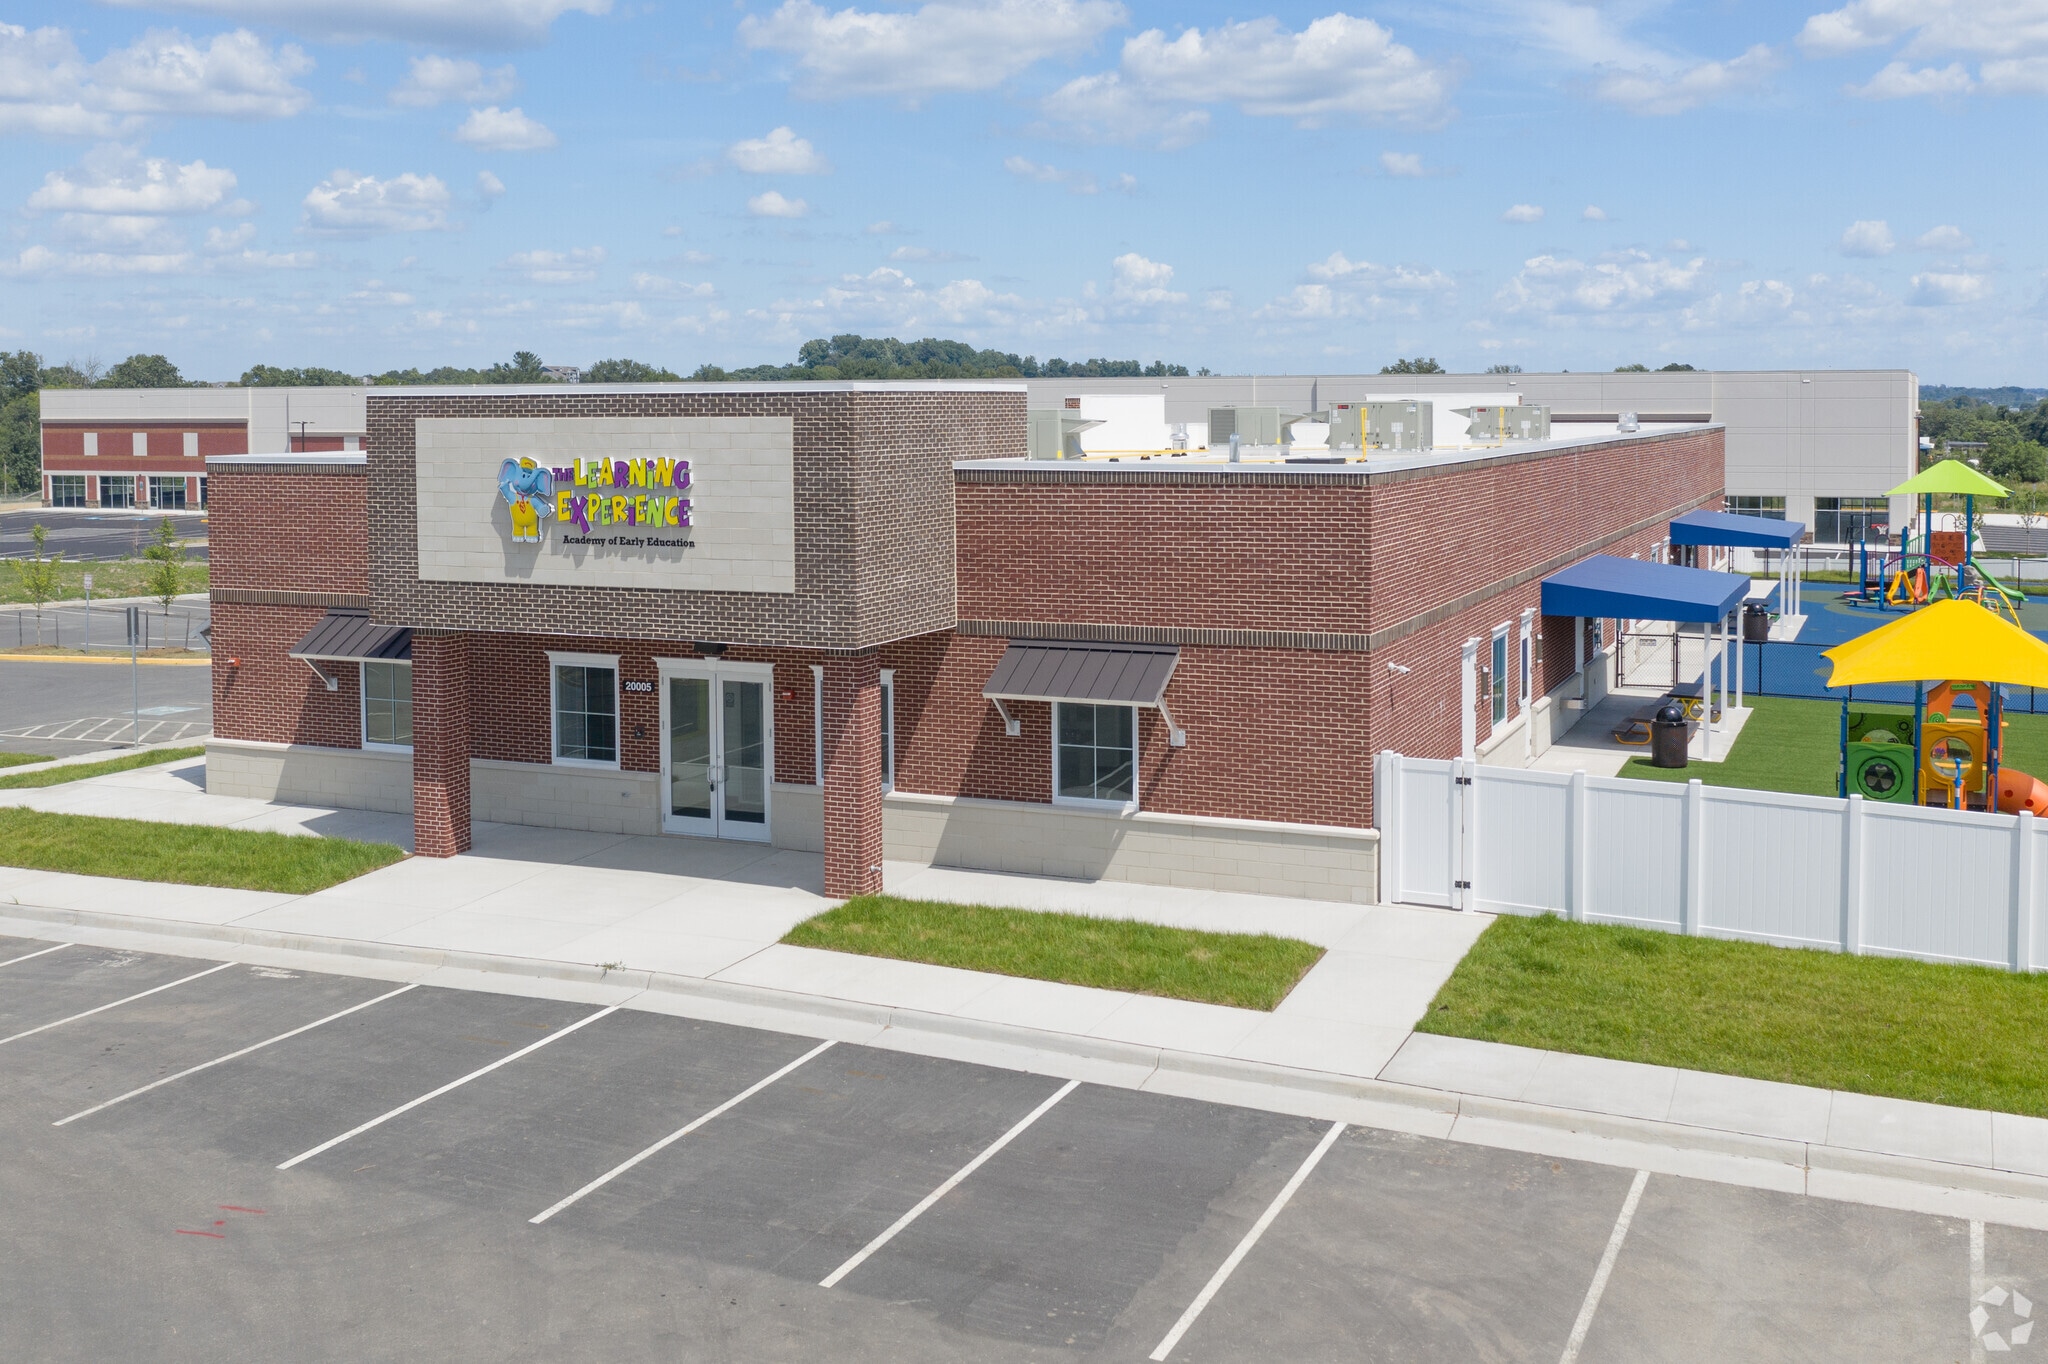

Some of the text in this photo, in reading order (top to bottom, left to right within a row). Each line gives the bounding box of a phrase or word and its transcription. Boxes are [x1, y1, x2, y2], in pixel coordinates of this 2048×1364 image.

[552, 467, 574, 481] THE
[563, 535, 696, 548] Academy of Early Education
[625, 681, 652, 692] 20005
